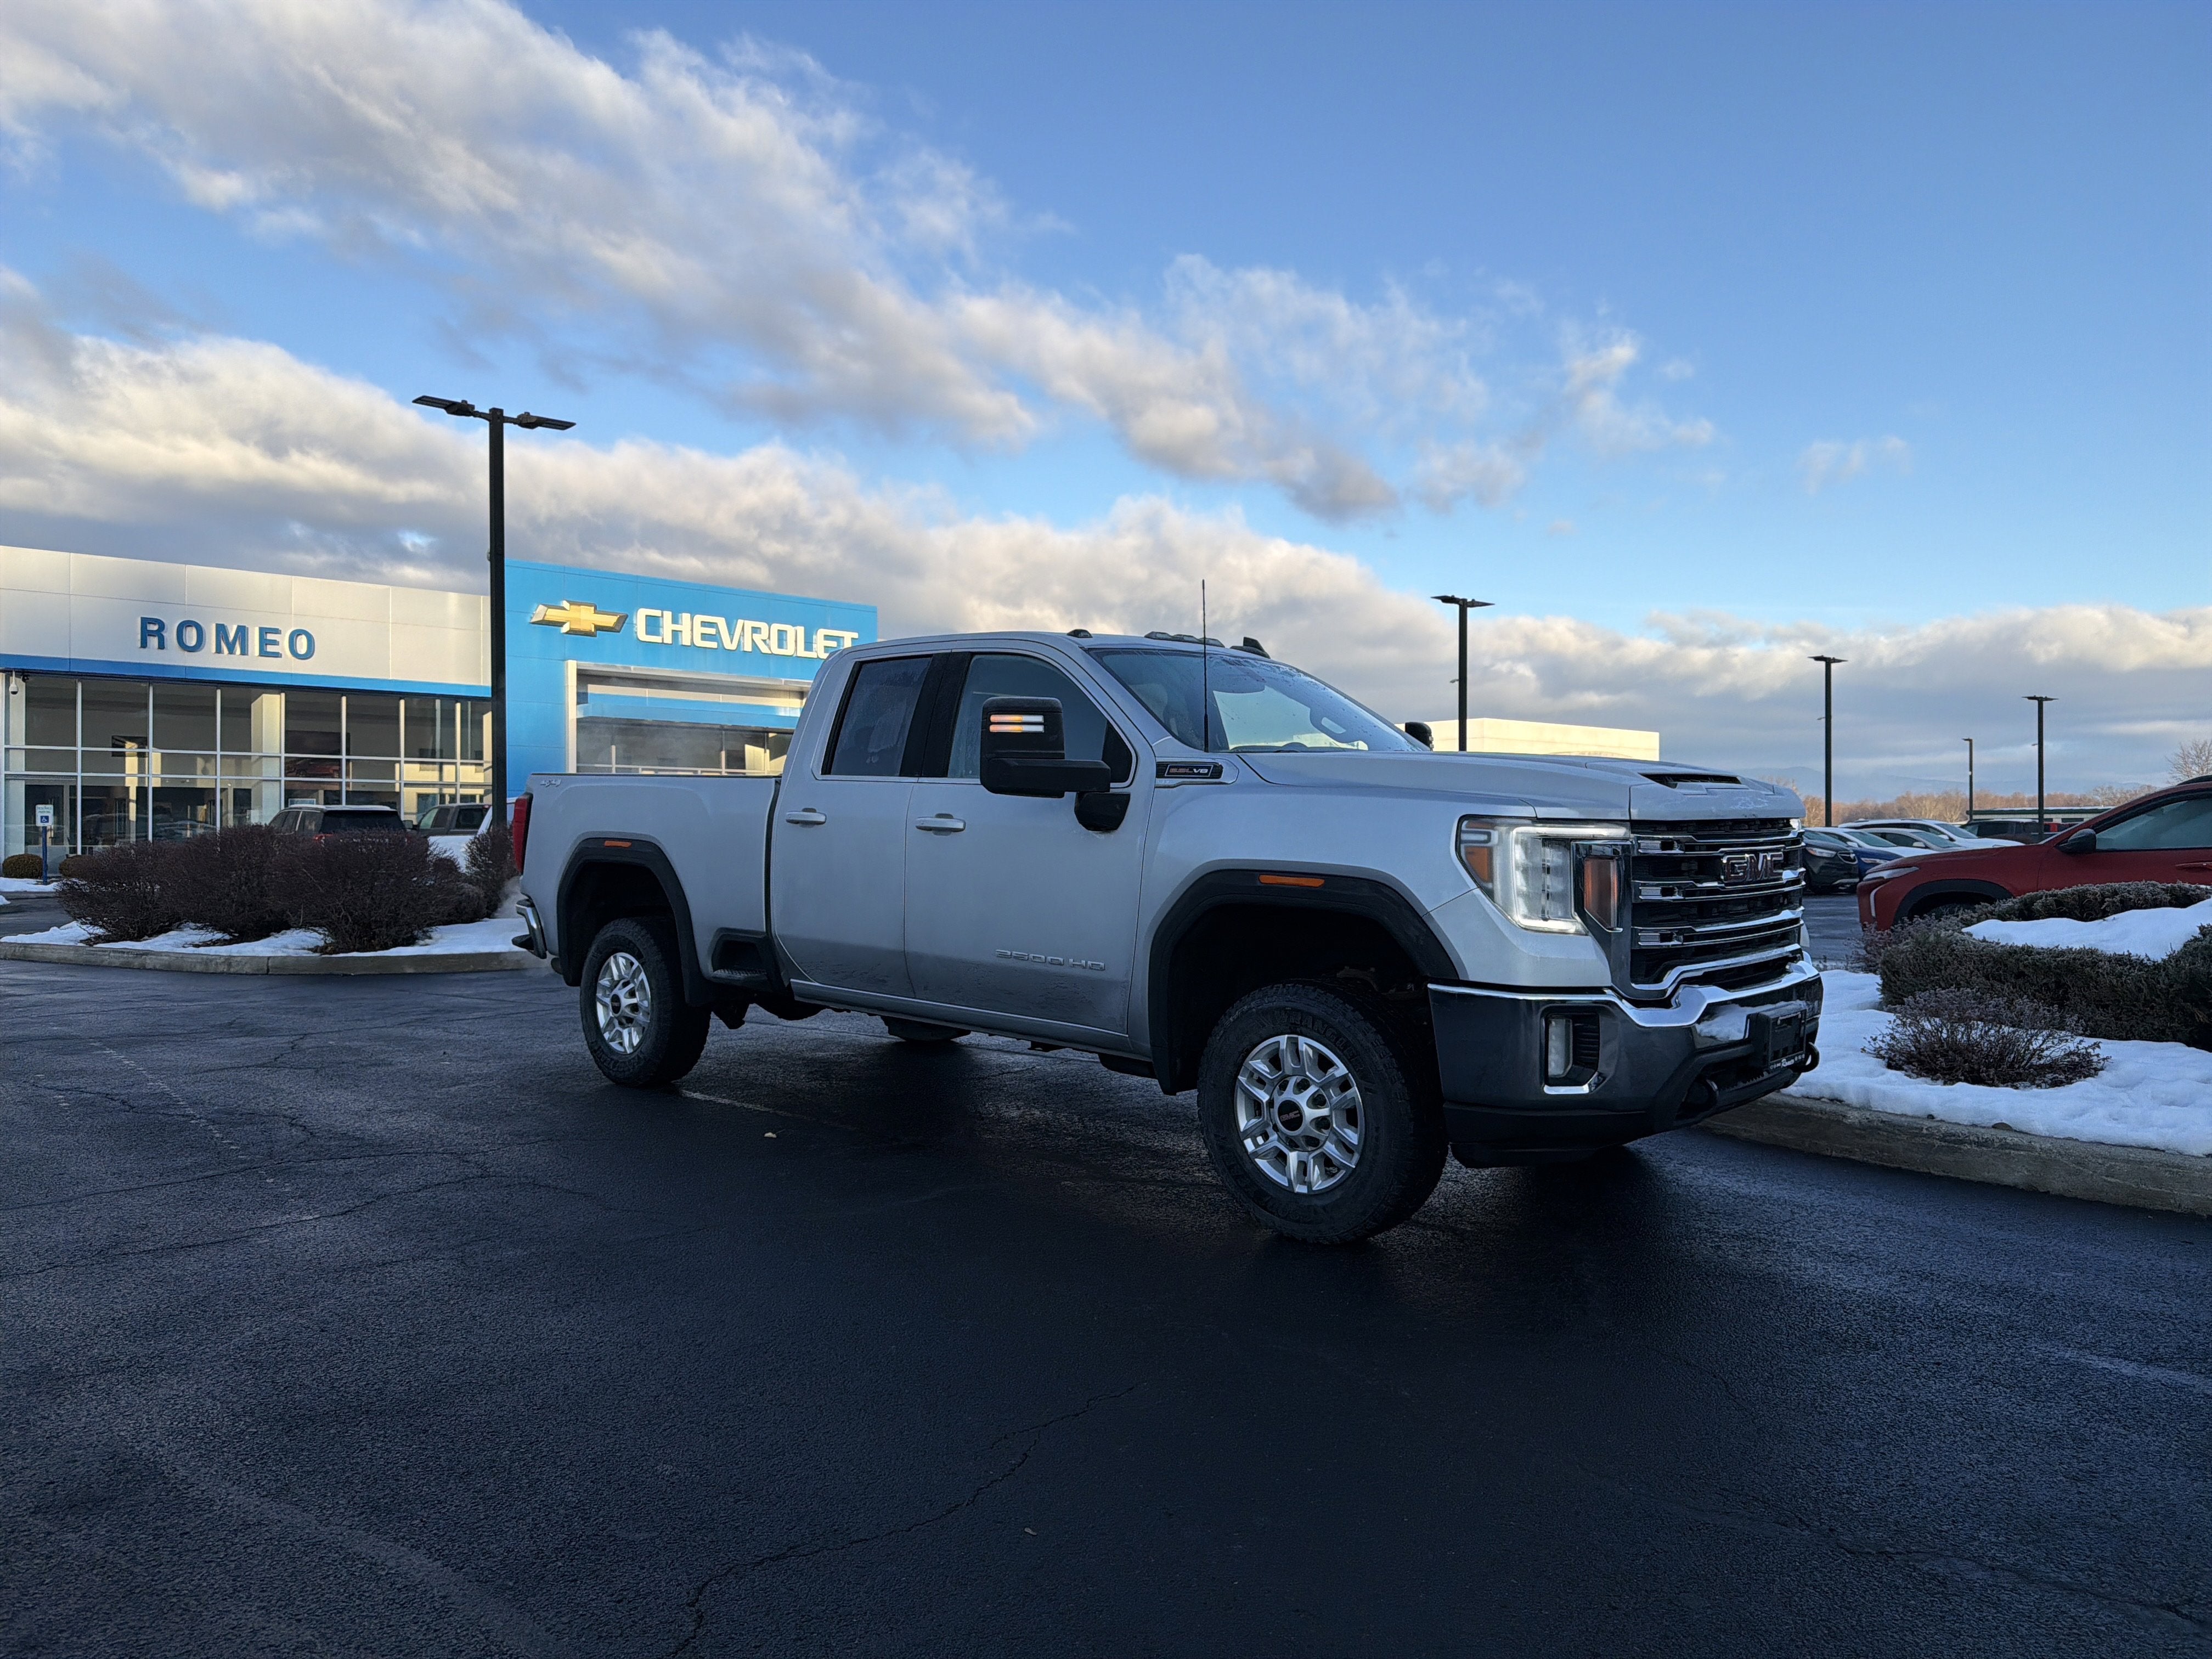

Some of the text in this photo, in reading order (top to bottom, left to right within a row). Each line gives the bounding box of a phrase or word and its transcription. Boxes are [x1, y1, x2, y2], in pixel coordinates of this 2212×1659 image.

[139, 616, 316, 660] ROMEO
[636, 608, 859, 659] CHEVROLET
[1722, 851, 1784, 883] GMC
[995, 949, 1105, 971] 2500 HD
